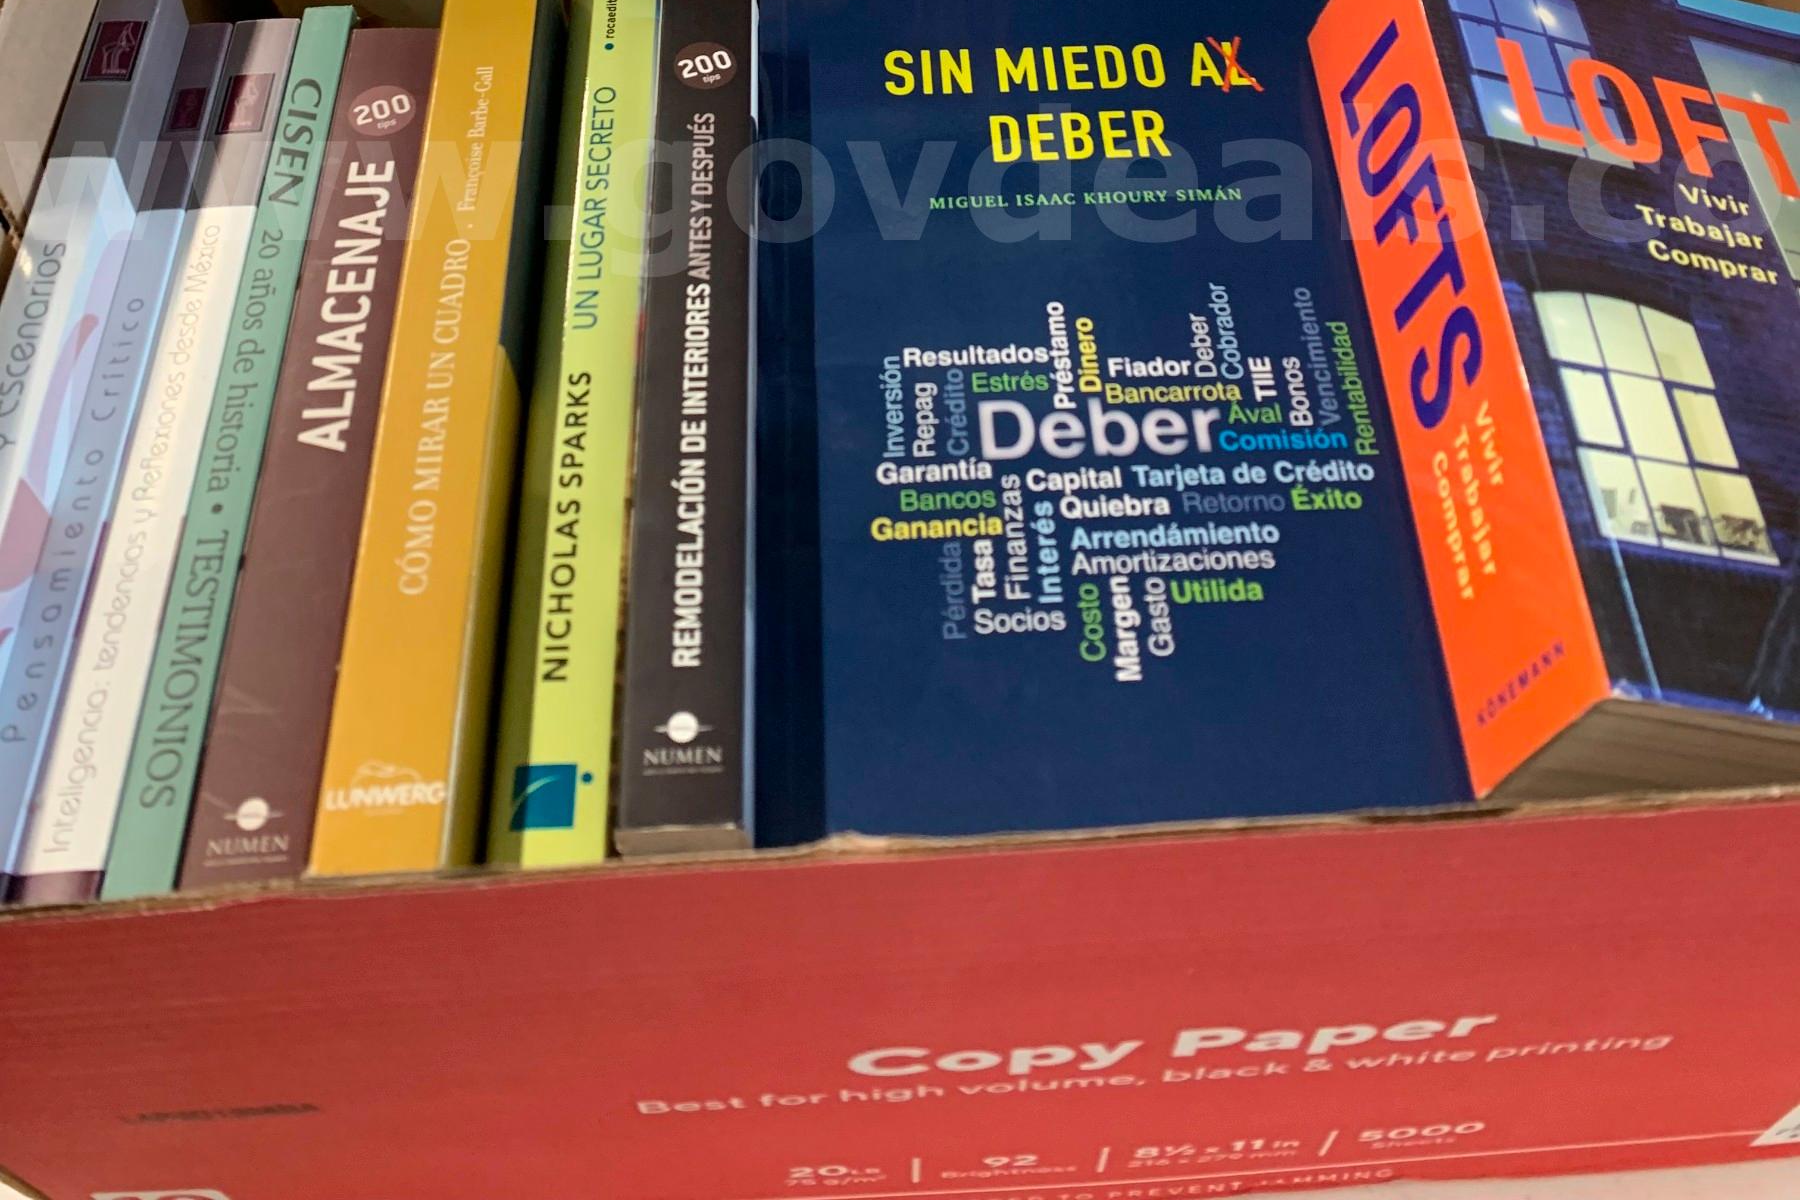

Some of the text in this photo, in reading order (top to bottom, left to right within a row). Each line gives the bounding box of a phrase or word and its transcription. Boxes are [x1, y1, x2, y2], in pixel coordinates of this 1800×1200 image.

[677, 50, 732, 79] 200
[702, 73, 721, 84] tips
[884, 49, 974, 95] SIN
[995, 43, 1166, 93] MIEDO
[353, 93, 411, 126] 200
[989, 110, 1172, 163] DEBER
[1496, 37, 1800, 200] LOFT
[930, 184, 1242, 210] MIGUEL ISAAC KHOURY SIMÁN
[1341, 19, 1483, 430] LOFTS
[1678, 183, 1749, 217] Vivir
[1636, 203, 1764, 252] Trabajar
[185, 224, 221, 294] México
[1648, 240, 1778, 286] Comprar
[297, 159, 395, 452] ALMACENAJE
[395, 66, 494, 595] CÓMO MIRAR UN CUADRO Françoise Barbe-Gall
[1209, 282, 1245, 380] Cobrador
[902, 345, 1049, 368] Resultados
[1046, 301, 1077, 409] Préstamo
[1076, 317, 1104, 392] Dinero
[1108, 357, 1191, 377] Fiador
[1189, 313, 1217, 377] Deber
[1294, 287, 1342, 426] Vencimiento
[542, 85, 616, 682] NICHOLAS SPARKS UN LUGAR SECRETO
[671, 112, 716, 667] REMODELACIÓN DE INTERIORES ANTES Y DESPUÉS
[881, 355, 906, 458] Inversión
[971, 370, 1049, 393] Estrés
[1105, 382, 1242, 405] Bancarrota
[1249, 357, 1278, 402] TIIE
[1283, 356, 1314, 426] Bonos
[1330, 321, 1380, 456] Rentabilidad
[944, 368, 970, 457] Crédito
[977, 396, 1221, 461] Deber
[1219, 429, 1348, 452] Comisión
[140, 78, 323, 809] CISEN 20 años de historia TESTIMONIOS
[876, 457, 993, 484] Garantía
[1474, 400, 1504, 485] Vivir
[900, 489, 996, 513] Bancos
[1026, 467, 1122, 493] Capital
[1131, 458, 1374, 493] Tarjeta de Crédito
[1291, 483, 1362, 511] Éxito
[1451, 425, 1497, 576] Trabajar
[2, 298, 145, 743] Pensamiento Crítico
[871, 515, 1003, 541] Ganancia
[1059, 492, 1171, 521] Quiebra
[1431, 452, 1475, 601] Comprar
[1001, 473, 1033, 600] Finanzas
[1033, 500, 1064, 604] Interés
[1071, 548, 1275, 576] Amortizaciones
[972, 539, 996, 603] Tasa
[973, 609, 1066, 634] Socios
[1080, 583, 1107, 662] Costo
[1111, 576, 1142, 682] Margen
[1146, 577, 1174, 656] Gasto
[643, 746, 723, 766] NUMEN
[327, 780, 448, 810] LUNWERG
[206, 835, 290, 856] NUMEN
[847, 1013, 1499, 1076] Copy Paper
[636, 1034, 1675, 1115] Best for high volume, black & white printing
[982, 1154, 1038, 1168] 92
[1228, 1139, 1264, 1152] 11
[1358, 1121, 1487, 1143] 5000
